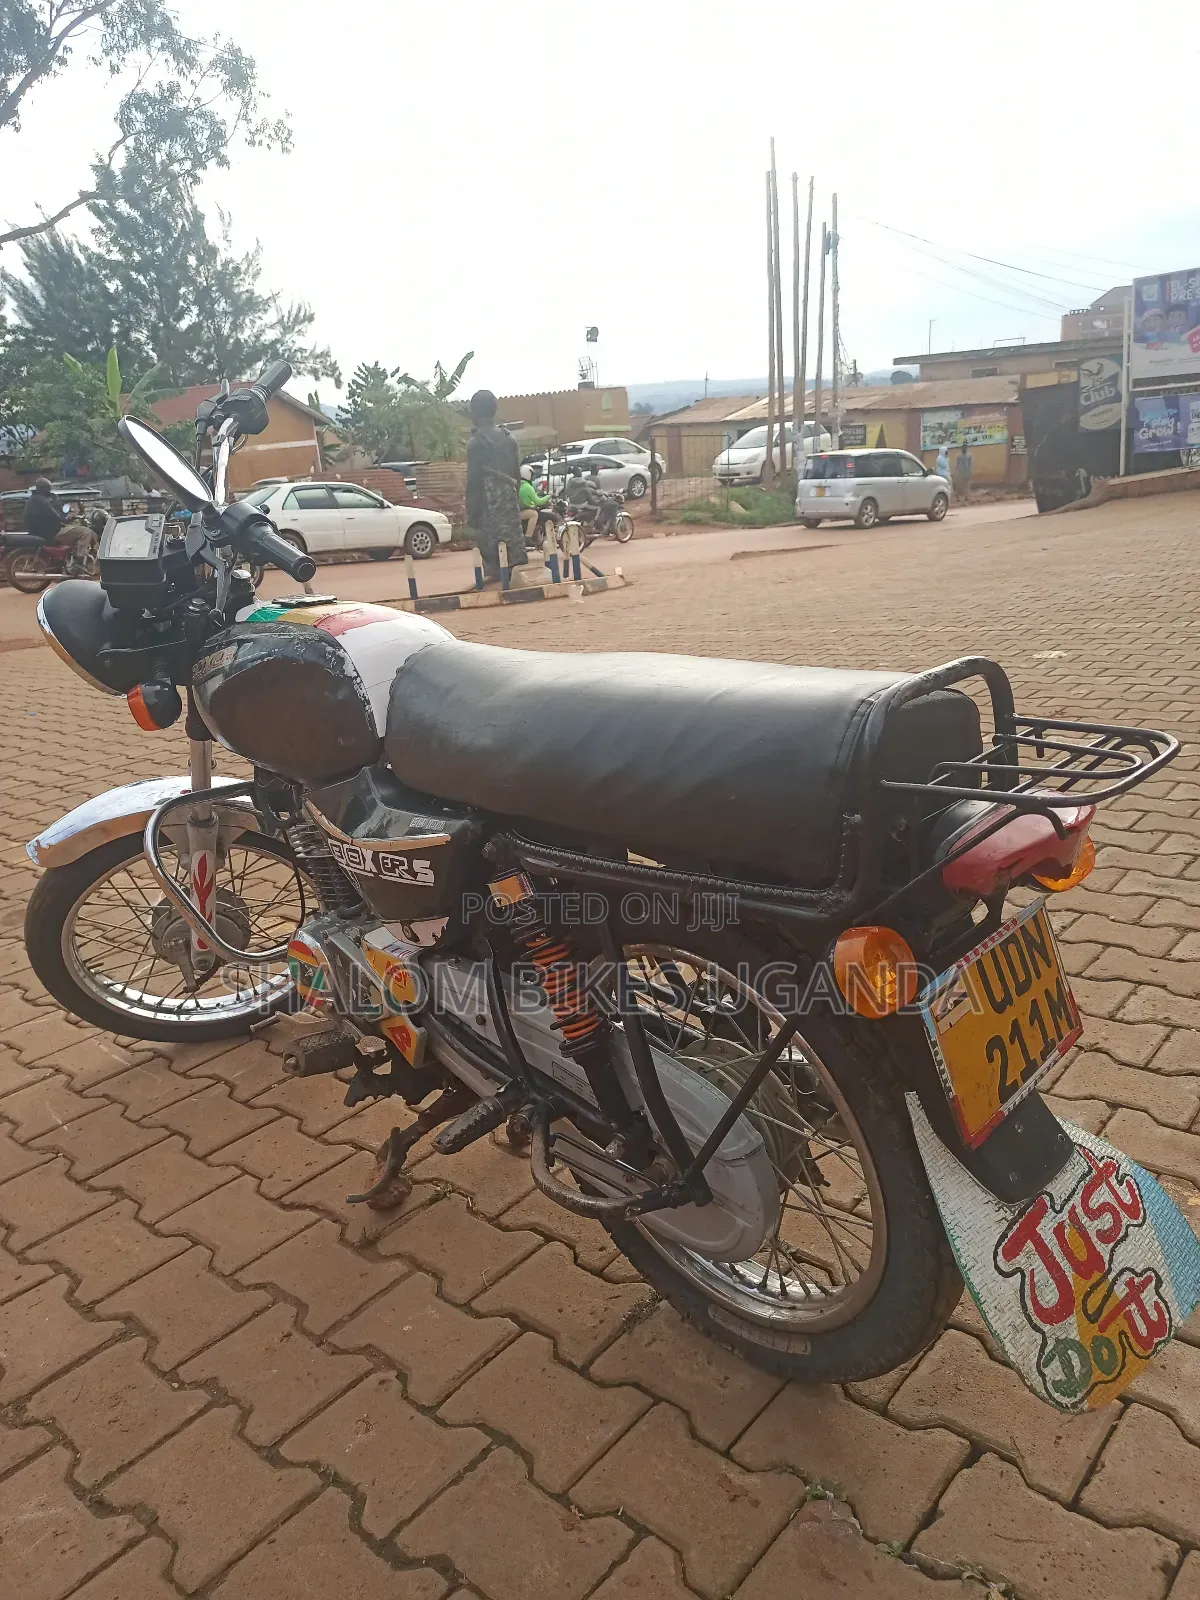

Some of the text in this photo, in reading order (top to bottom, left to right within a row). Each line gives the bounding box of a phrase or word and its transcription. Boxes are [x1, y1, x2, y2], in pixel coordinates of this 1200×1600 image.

[1170, 289, 1193, 302] PRE
[1080, 385, 1116, 406] Club
[976, 914, 1051, 1015] UDN
[985, 976, 1074, 1106] 211M
[1001, 1147, 1144, 1326] Just
[1042, 1336, 1118, 1398] Do
